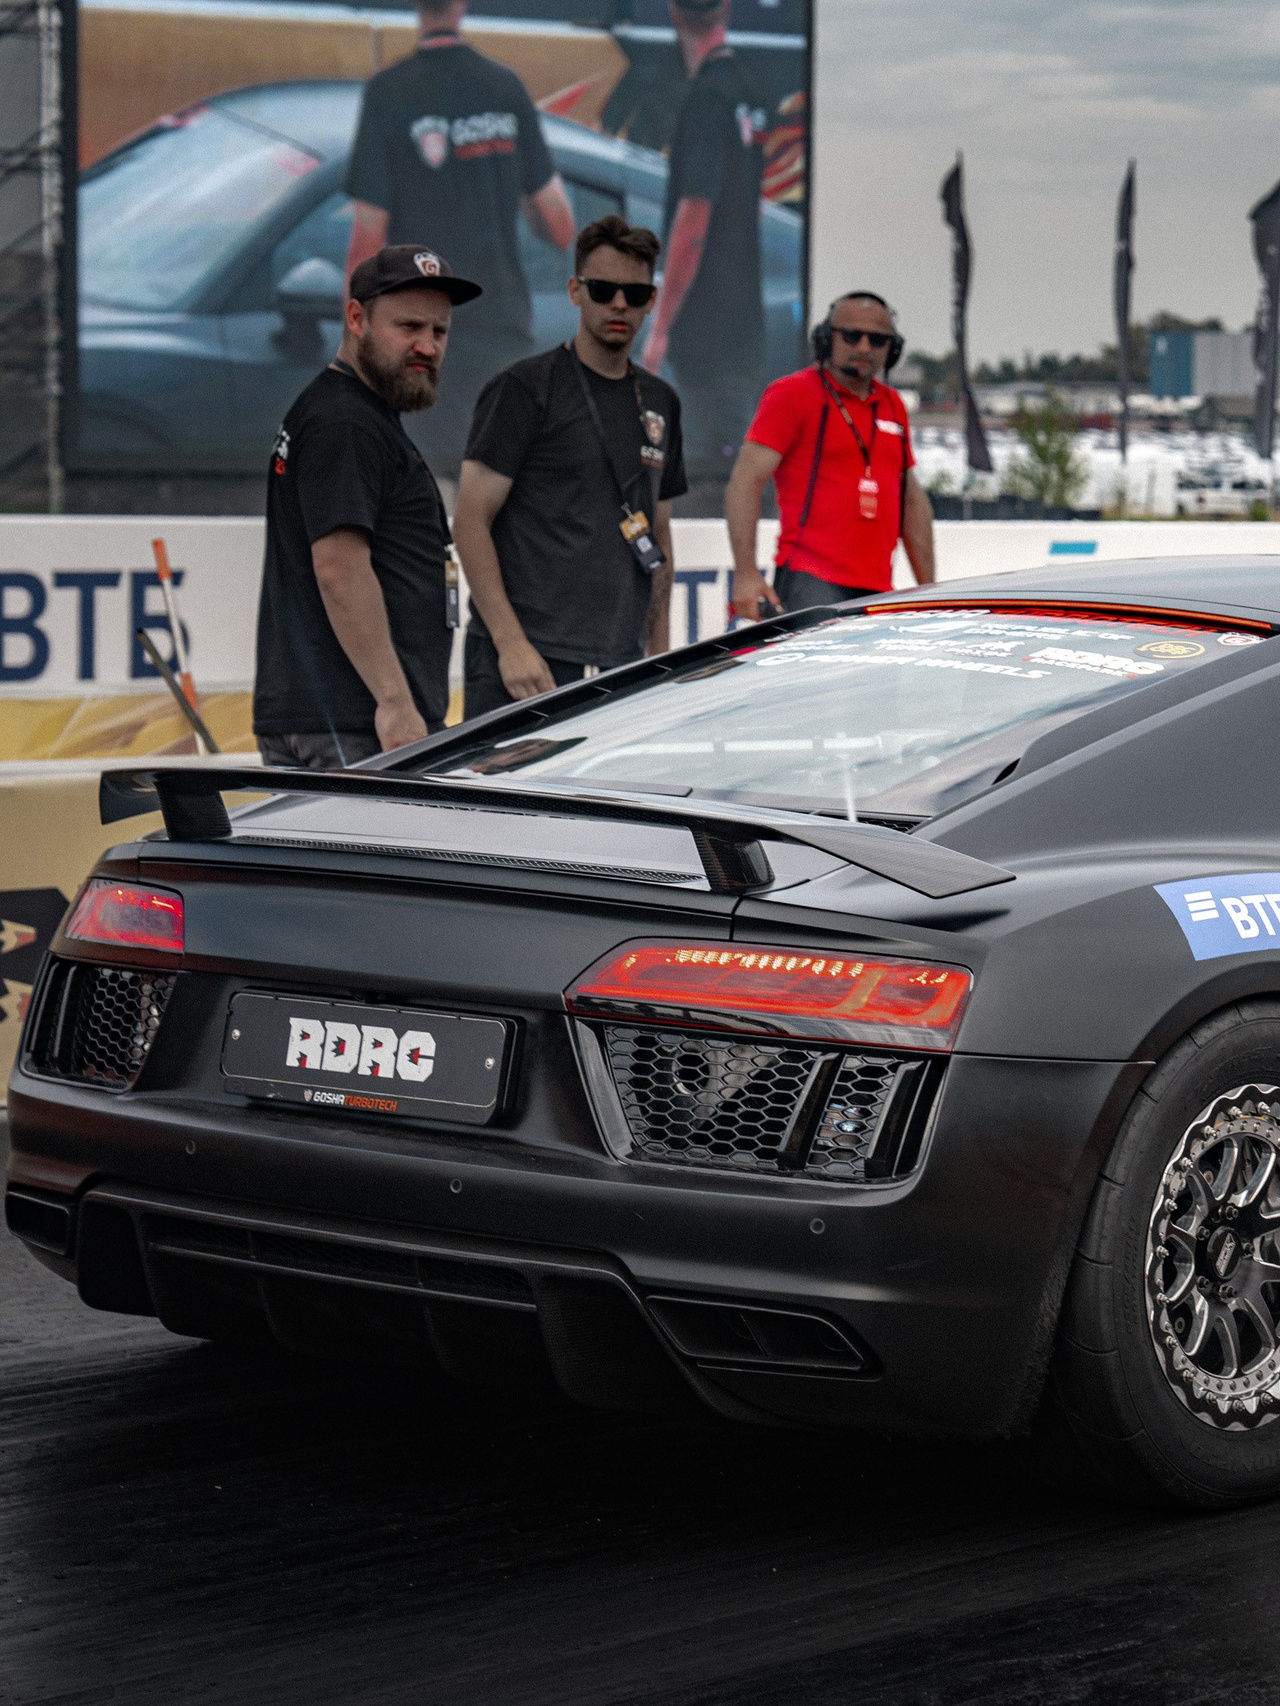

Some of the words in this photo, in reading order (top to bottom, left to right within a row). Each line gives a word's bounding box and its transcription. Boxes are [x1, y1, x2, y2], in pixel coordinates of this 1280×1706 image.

[0, 568, 190, 683] ВТБ
[1029, 646, 1165, 675] RDRC
[285, 1016, 437, 1083] RDRC
